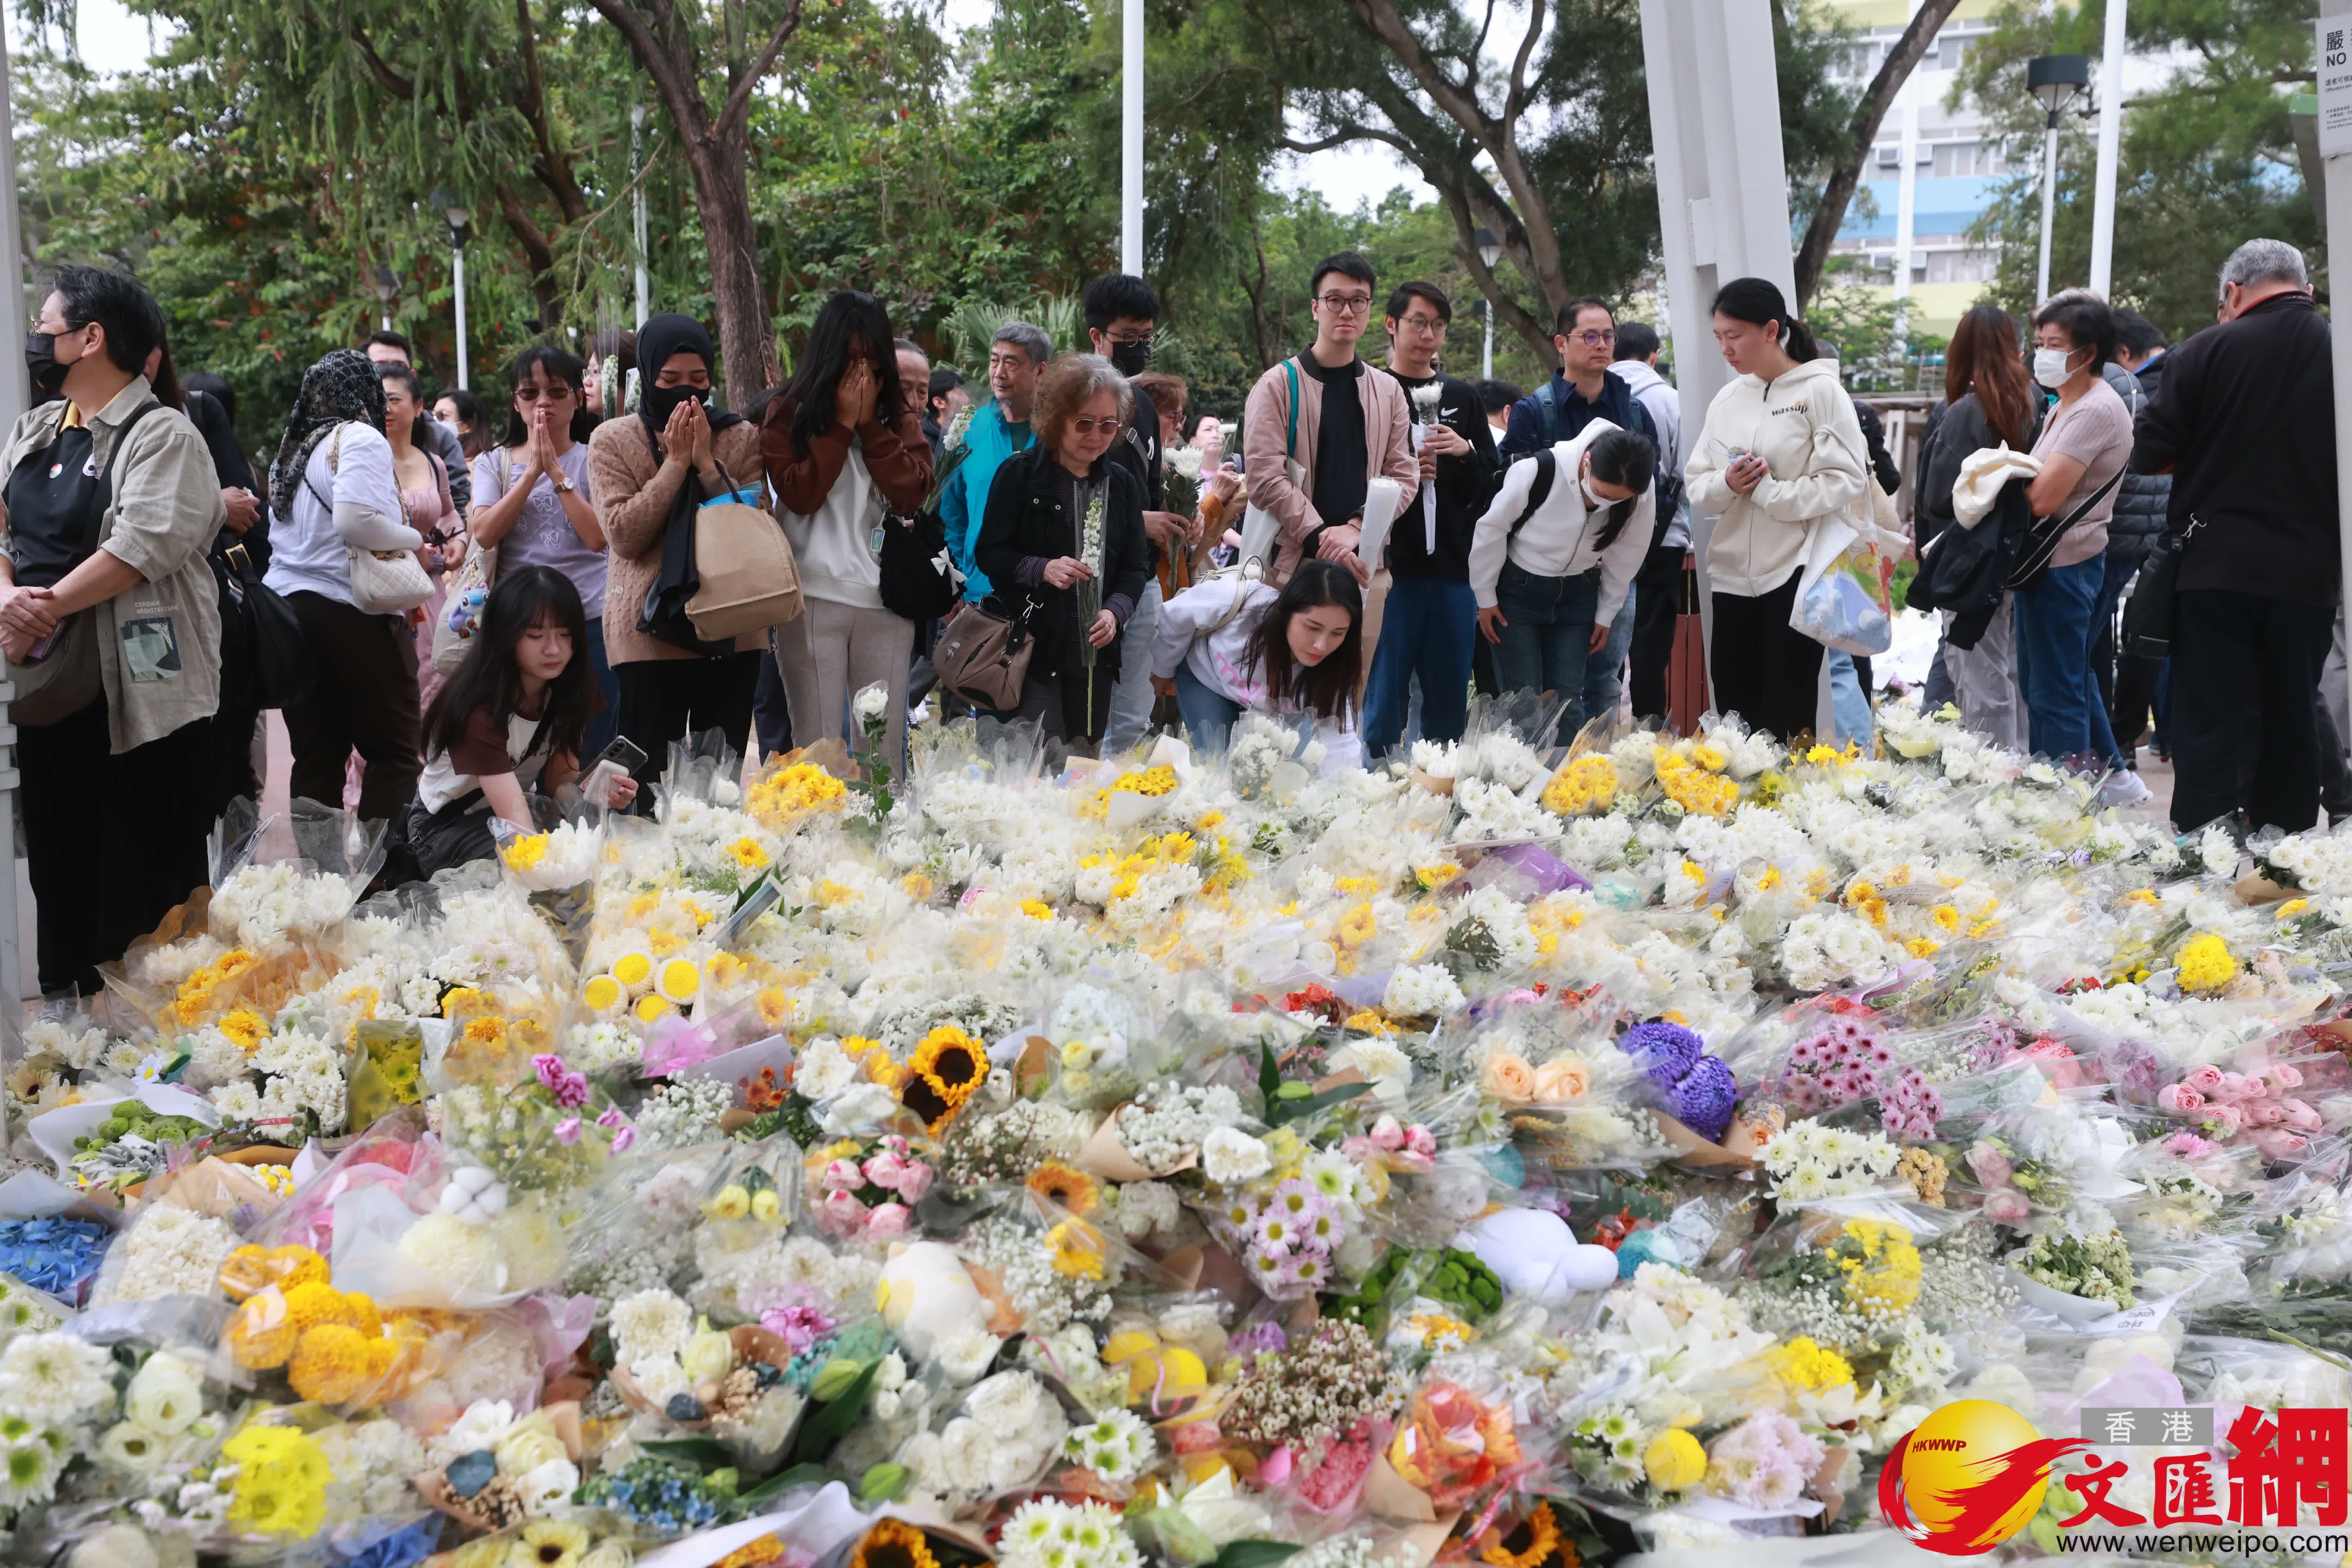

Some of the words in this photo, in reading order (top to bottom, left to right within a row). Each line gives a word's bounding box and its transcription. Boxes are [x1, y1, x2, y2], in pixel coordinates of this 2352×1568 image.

[2327, 29, 2352, 52] 嚴
[2327, 52, 2347, 67] NO
[1772, 404, 1808, 416] wassup
[136, 605, 179, 614] ARCHITECTURE
